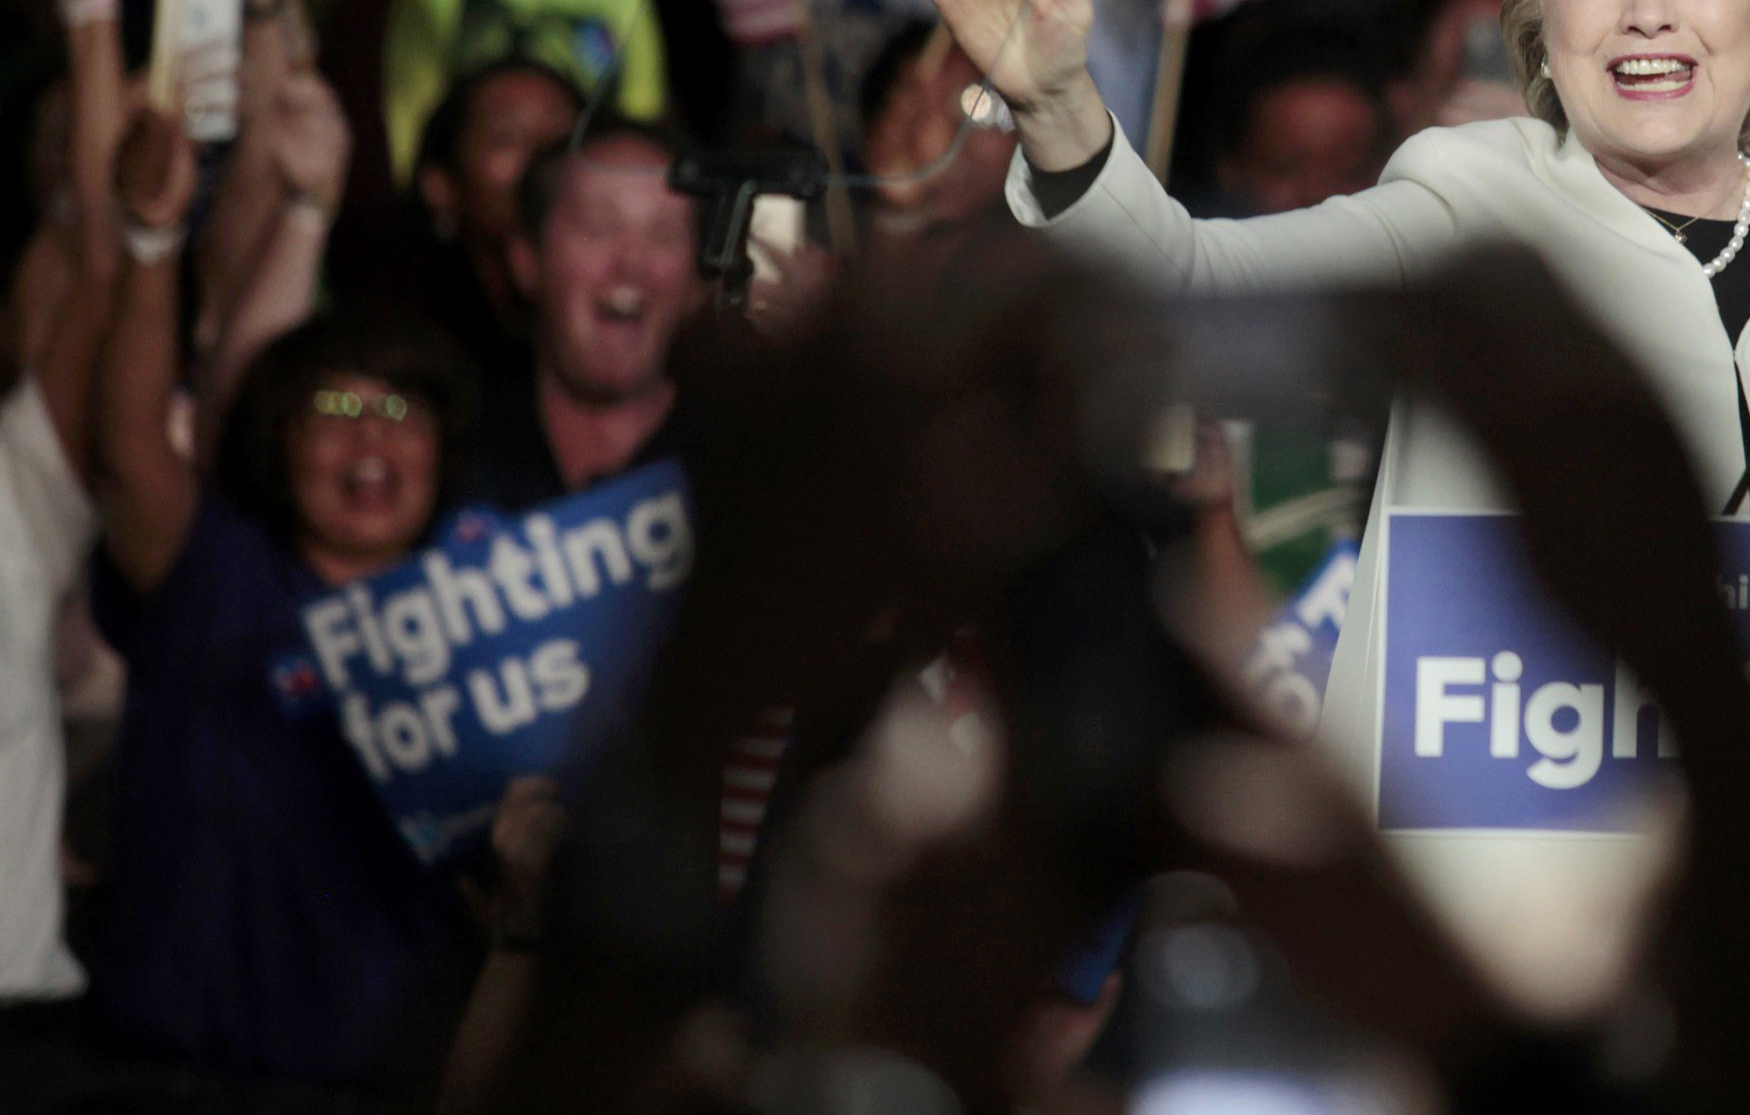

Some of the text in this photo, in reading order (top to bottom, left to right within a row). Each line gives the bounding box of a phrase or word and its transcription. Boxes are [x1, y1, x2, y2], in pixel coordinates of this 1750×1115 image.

[304, 488, 694, 692] Fighting
[340, 637, 592, 784] for us
